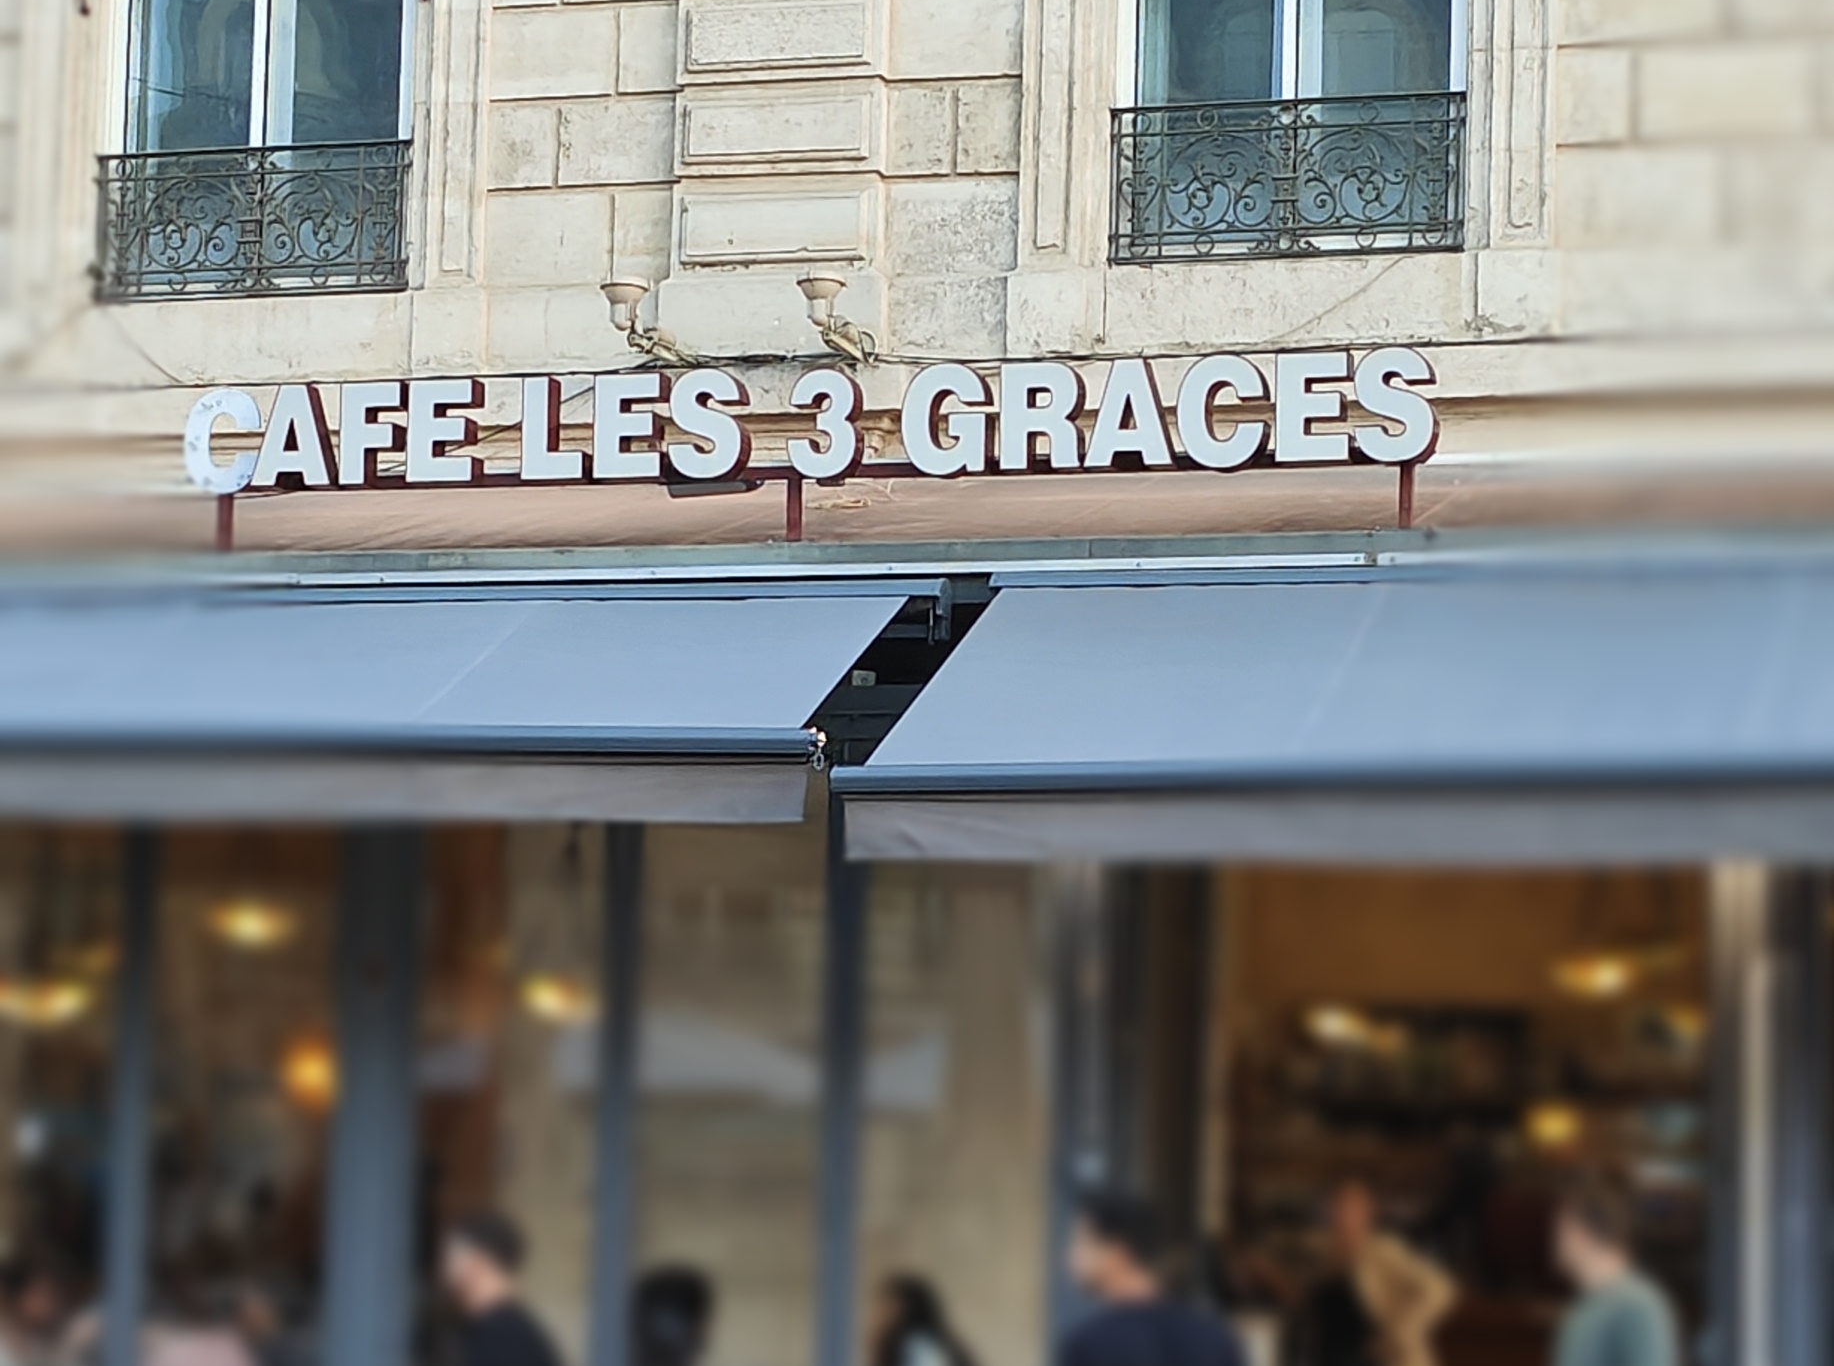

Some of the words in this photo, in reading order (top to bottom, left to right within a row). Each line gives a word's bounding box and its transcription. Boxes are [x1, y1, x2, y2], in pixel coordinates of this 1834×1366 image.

[184, 378, 482, 495] CAFE
[520, 368, 747, 480] LES
[787, 368, 860, 479] 3
[901, 346, 1438, 477] GRACES
